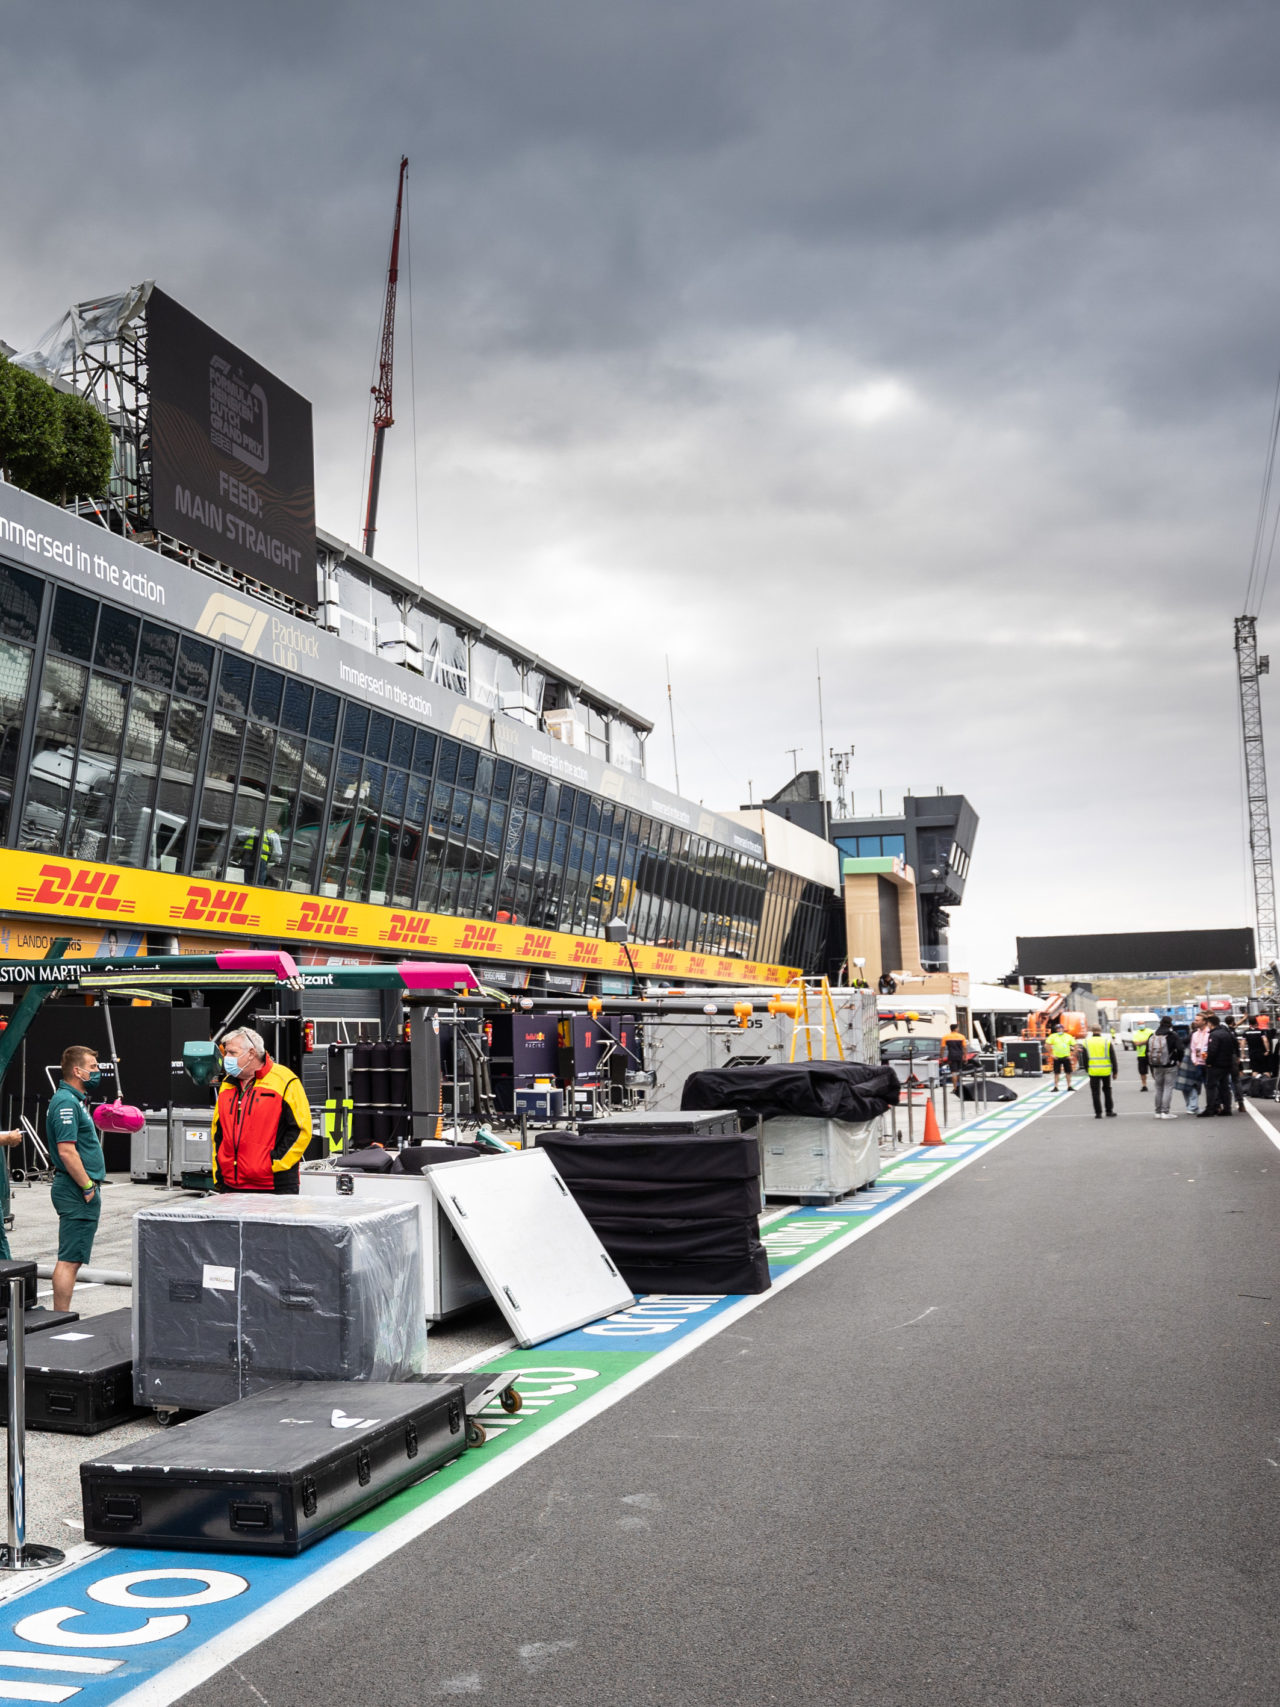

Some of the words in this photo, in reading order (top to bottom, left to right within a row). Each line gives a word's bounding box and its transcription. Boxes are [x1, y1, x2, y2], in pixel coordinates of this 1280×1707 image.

[210, 398, 240, 429] DUTCH
[210, 413, 242, 444] GRAND
[220, 470, 263, 518] FEED:
[175, 484, 222, 534] MAIN
[226, 513, 301, 574] STRAIGHT
[77, 545, 91, 573] in
[94, 555, 119, 585] the
[122, 570, 165, 605] action
[272, 617, 319, 659] Paddock
[273, 641, 298, 671] Club
[340, 661, 384, 696] Immersed
[385, 680, 392, 700] in
[393, 685, 408, 706] the
[408, 690, 431, 717] action
[34, 865, 121, 911] DHL
[183, 886, 248, 924] DHL
[297, 902, 349, 935] DHL
[17, 934, 48, 949] LANDO
[388, 915, 431, 945] DHL
[462, 925, 496, 953] DHL
[523, 933, 551, 957] DHL
[573, 941, 599, 964] DHL
